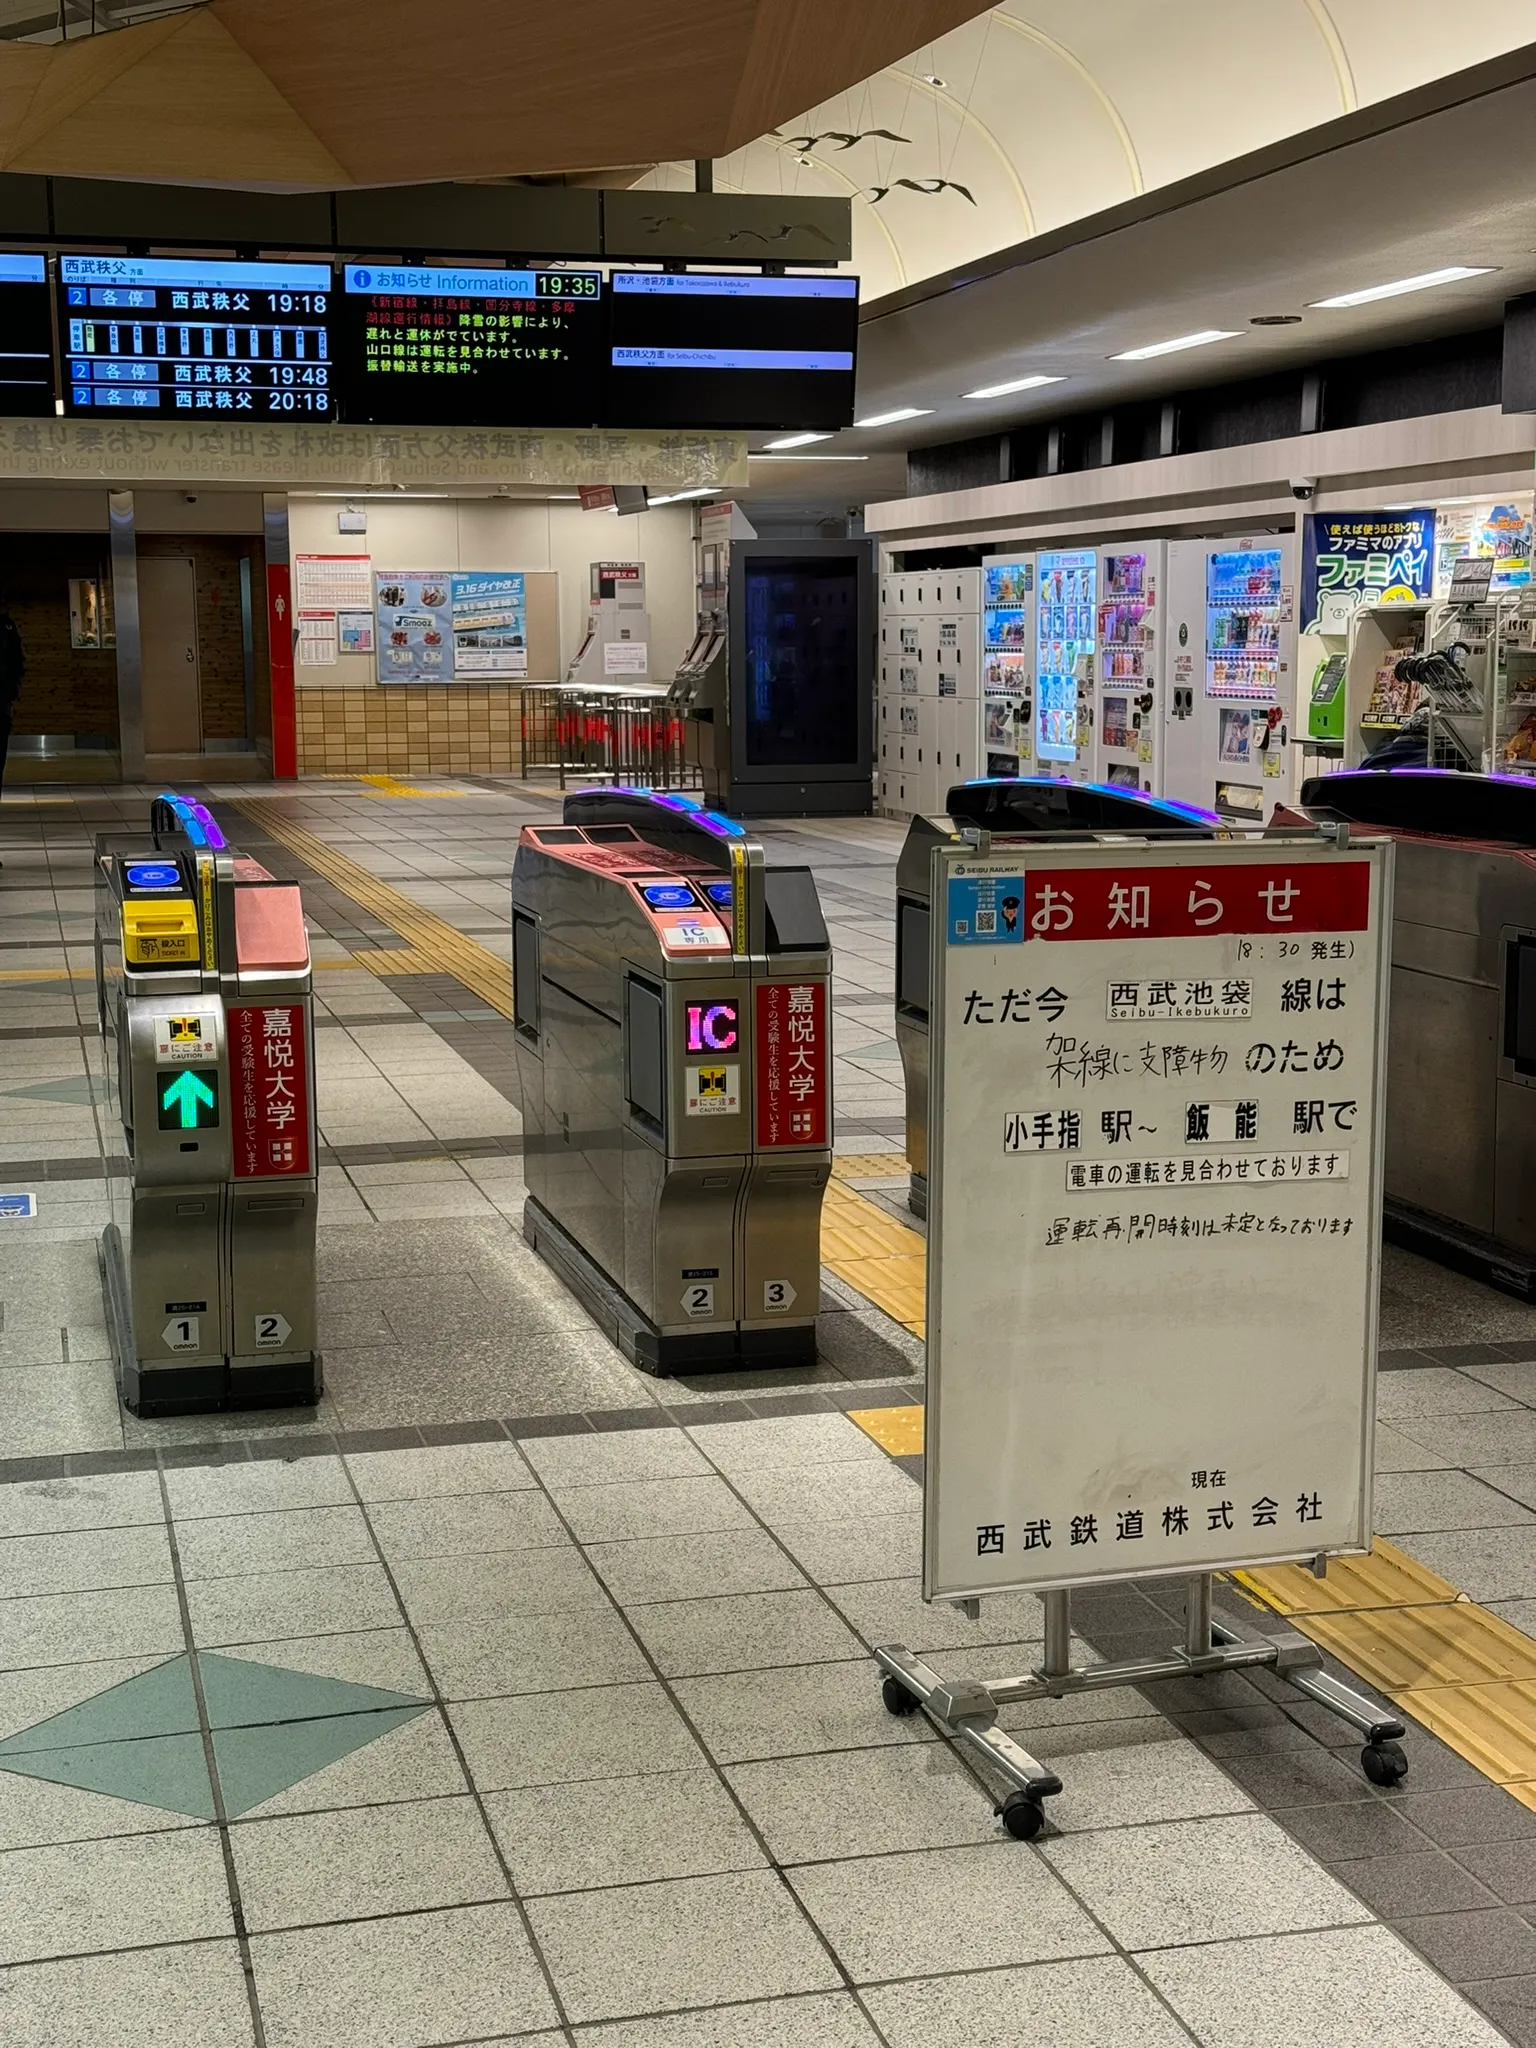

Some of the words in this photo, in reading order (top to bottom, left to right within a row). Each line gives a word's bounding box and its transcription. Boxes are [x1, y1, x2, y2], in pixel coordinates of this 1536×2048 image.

[65, 259, 127, 275] 西武秩父
[377, 272, 431, 289] お知らせ
[437, 273, 529, 292] Information
[539, 275, 596, 295] 19:35
[72, 290, 82, 305] 2
[102, 290, 144, 306] 各停
[171, 291, 250, 311] 西武秩父
[267, 293, 327, 313] 19:18
[366, 328, 517, 344] 遅れと運休がでています。
[366, 344, 569, 361] 山口線は運転を見合わせています。
[617, 349, 665, 359] 西武秩父方面
[76, 365, 86, 379] 2
[105, 363, 147, 380] 各停
[174, 365, 252, 383] 西武秩父
[269, 366, 328, 386] 19:48
[366, 359, 478, 375] 振替輸送を実施中。
[77, 390, 88, 404] 2
[106, 389, 148, 406] 各停
[175, 391, 253, 410] 西武秩父
[269, 391, 328, 411] 20:18
[1330, 521, 1420, 536] 使えば使うほどおトクな
[1328, 534, 1423, 552] ファミマのアプリ
[1316, 549, 1429, 587] ファミペイ
[403, 618, 433, 628] Smooz
[989, 865, 1019, 873] RAILWAY
[1031, 878, 1300, 932] お知らせ
[682, 927, 705, 936] IC
[161, 939, 186, 948] 投入口
[1110, 980, 1251, 1007] 西武池袋
[1280, 976, 1348, 1013] 線は
[963, 985, 1070, 1026] ただ今
[1111, 1005, 1250, 1019] Seibu-Ikebukuro
[687, 1006, 736, 1050] IC
[788, 985, 815, 1103] 嘉悦大学
[171, 1052, 203, 1060] CAUTION
[767, 987, 780, 1144] 全ての受験生を応援しています
[1045, 1032, 1229, 1089] 架線に支障物
[1245, 1038, 1346, 1074] のため
[262, 1008, 296, 1130] 嘉悦大学
[240, 1010, 258, 1174] 全ての受験生を応援しています
[1185, 1101, 1258, 1141] 飯能
[1292, 1099, 1358, 1134] 駅で
[1004, 1111, 1081, 1150] 小手指
[1070, 1153, 1340, 1188] 電車の運転を見合わせております
[692, 1288, 709, 1308] 2
[768, 1283, 785, 1303] 3
[177, 1321, 190, 1341] 1
[260, 1317, 279, 1338] 2
[1190, 1468, 1227, 1490] 現在
[976, 1491, 1324, 1557] 西武鉄道株式会社
